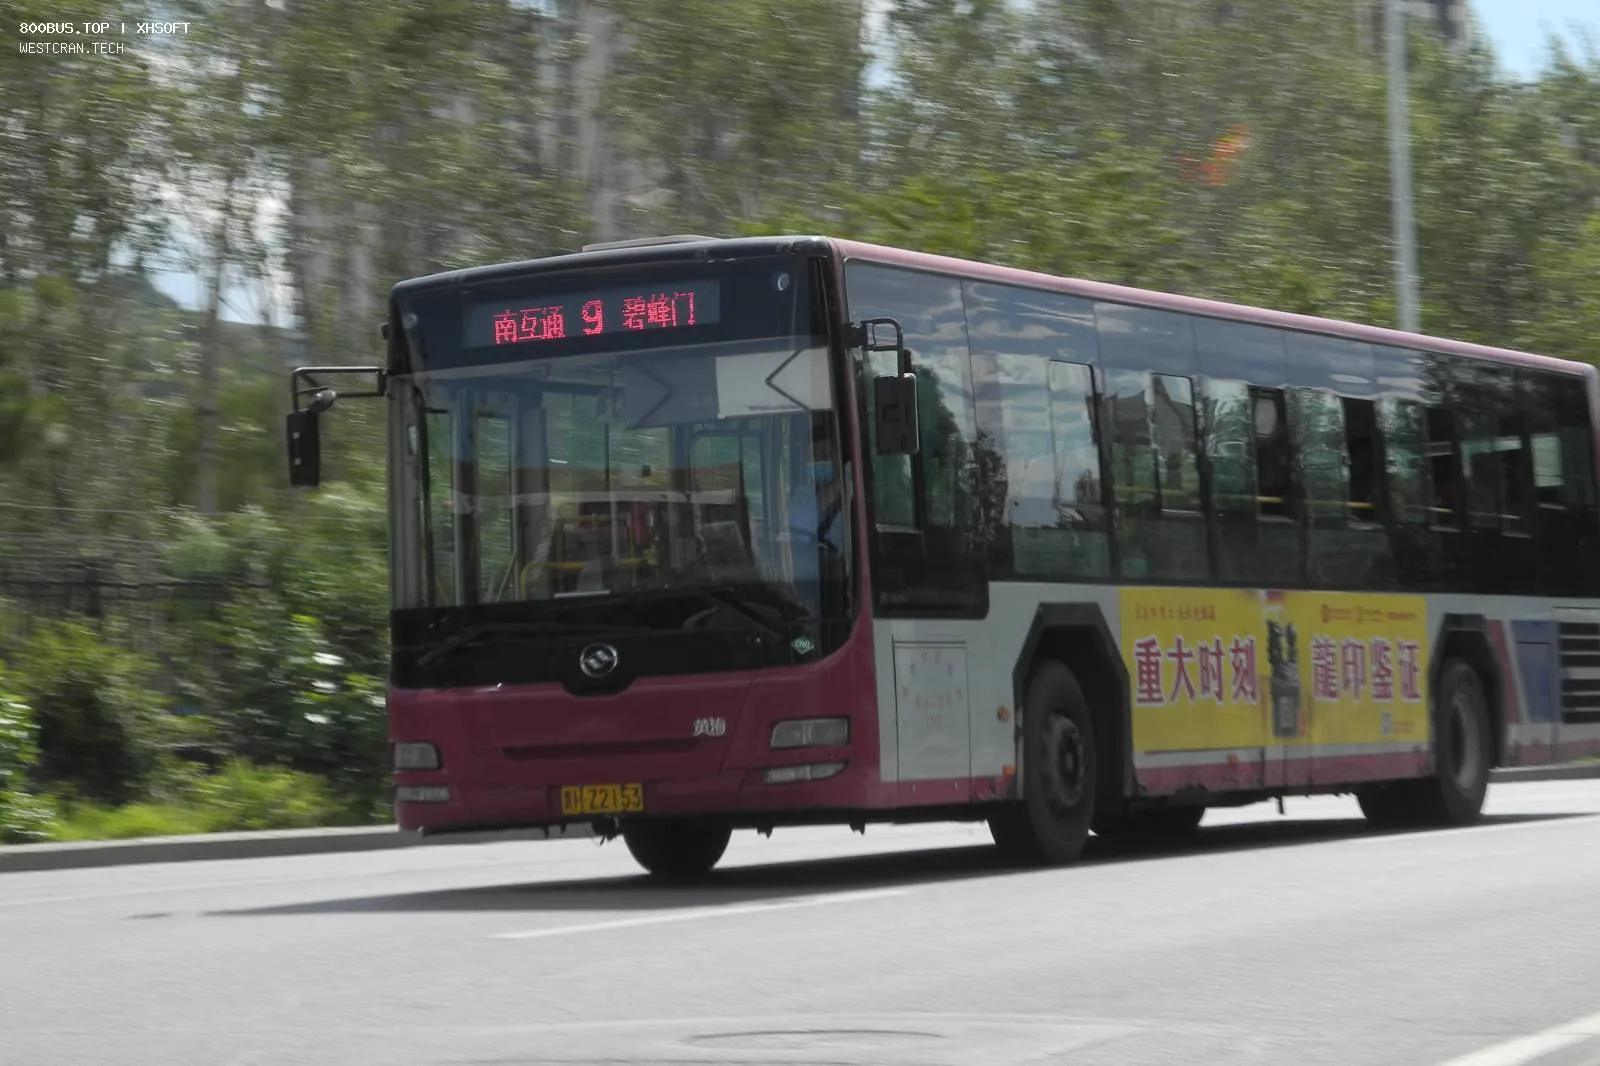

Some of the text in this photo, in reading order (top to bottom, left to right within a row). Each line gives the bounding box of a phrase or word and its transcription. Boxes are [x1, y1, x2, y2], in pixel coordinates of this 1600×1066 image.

[493, 290, 697, 345] 南互通 9 碧峰门
[1134, 635, 1258, 706] 重大时刻
